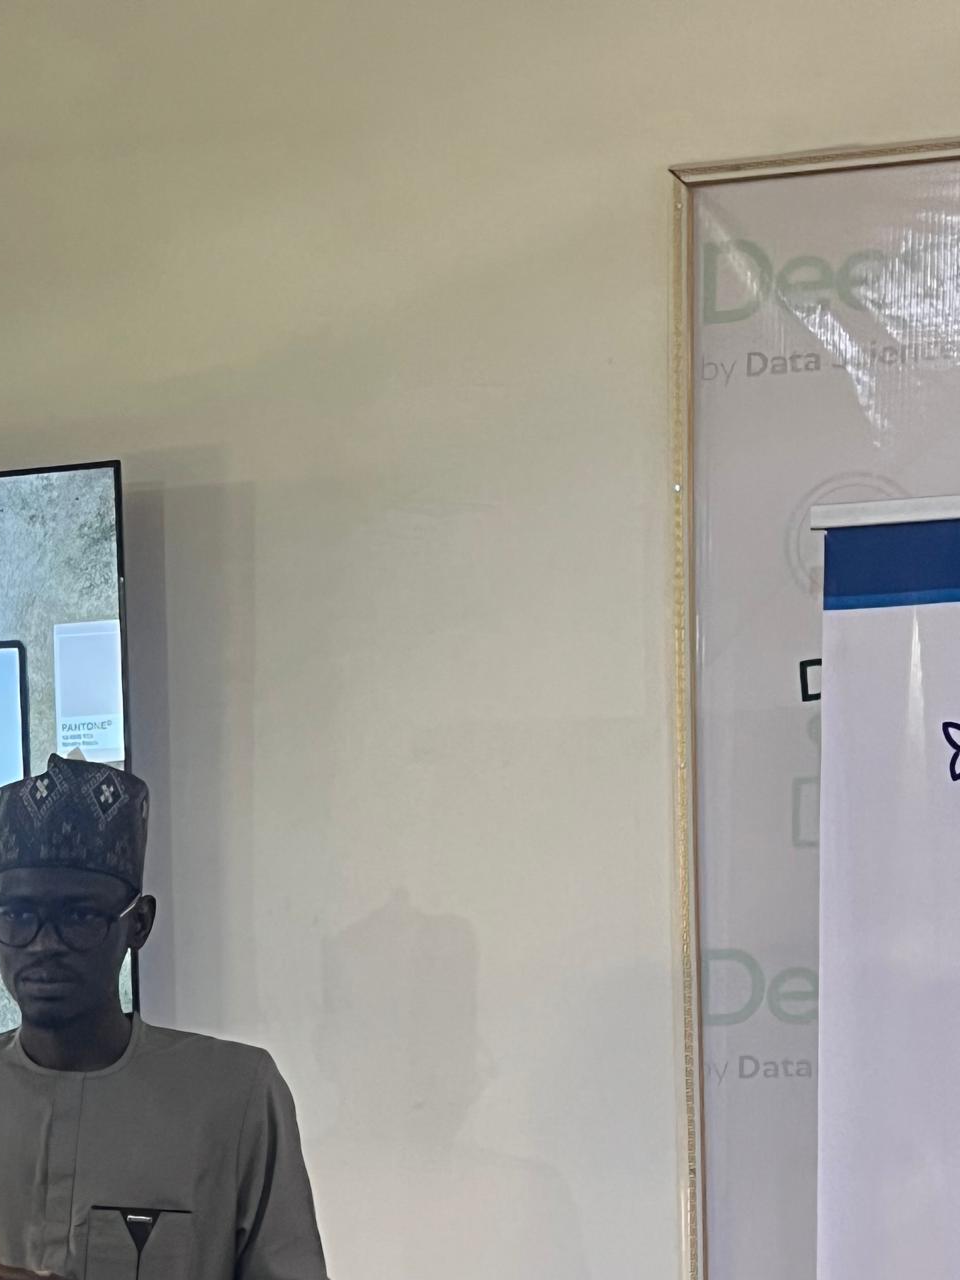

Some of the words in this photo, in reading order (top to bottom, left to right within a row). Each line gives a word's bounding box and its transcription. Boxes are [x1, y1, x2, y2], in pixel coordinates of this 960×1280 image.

[701, 355, 736, 388] by
[746, 351, 821, 378] Data
[738, 1055, 812, 1079] Data
